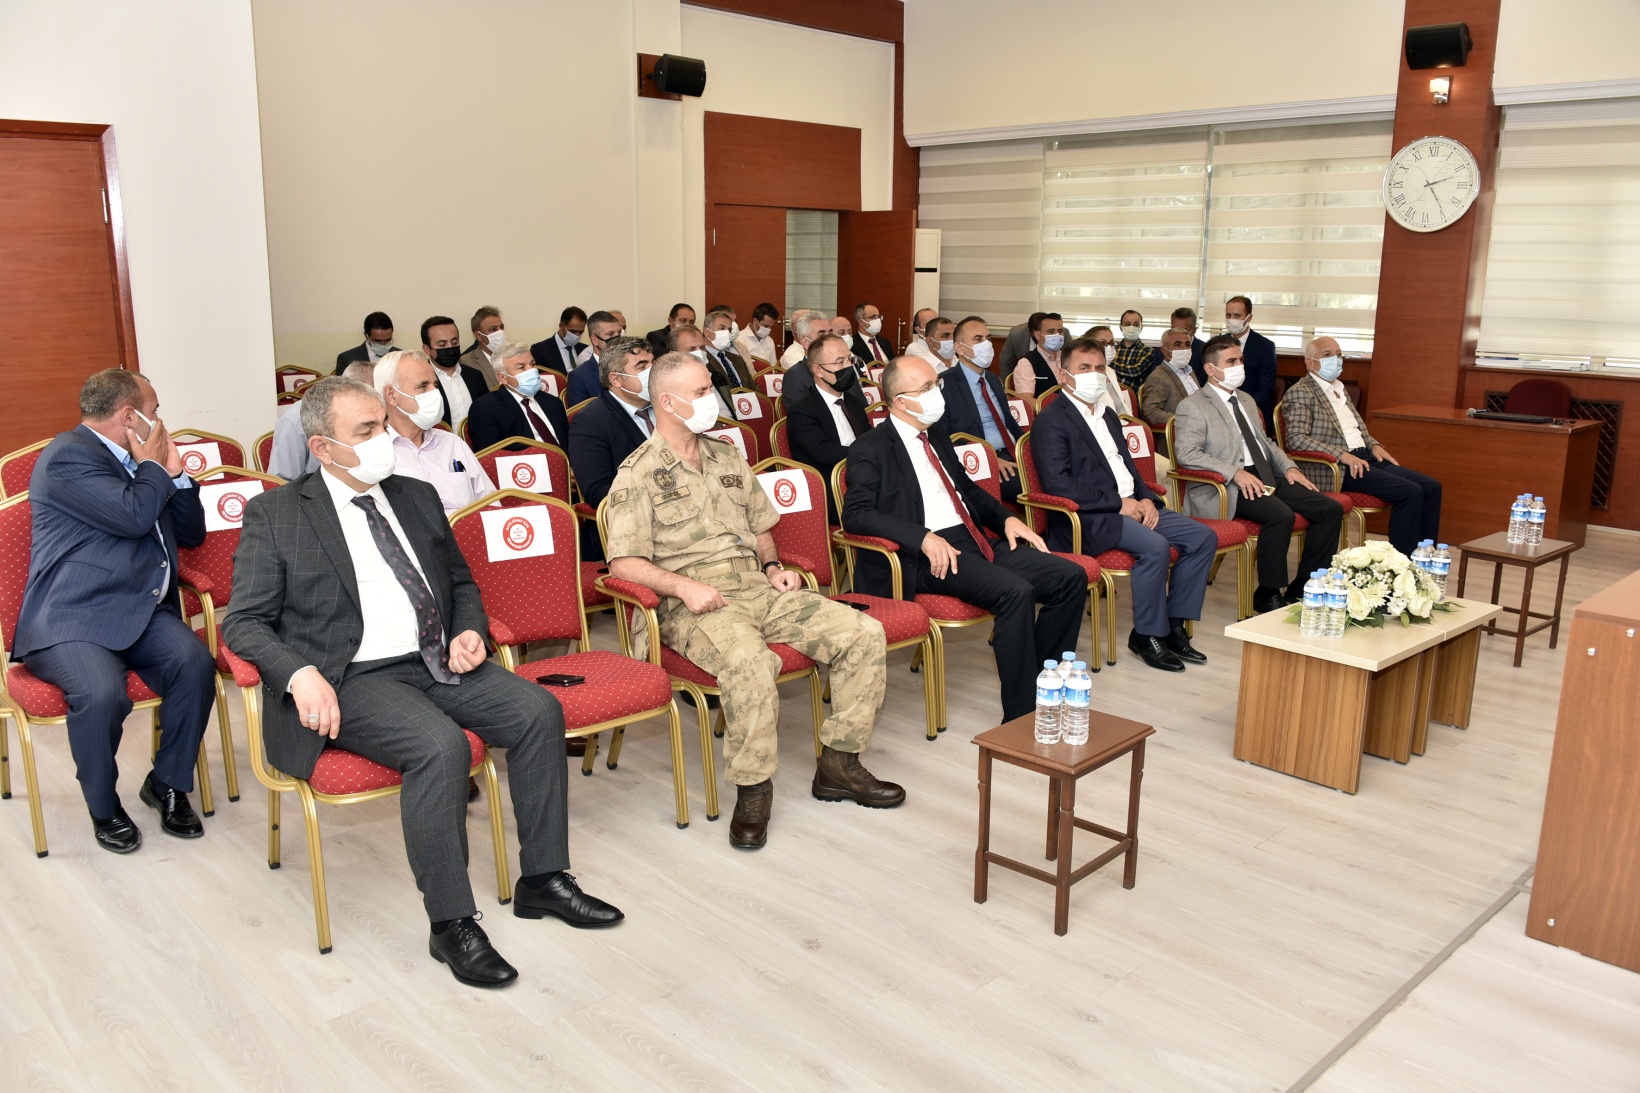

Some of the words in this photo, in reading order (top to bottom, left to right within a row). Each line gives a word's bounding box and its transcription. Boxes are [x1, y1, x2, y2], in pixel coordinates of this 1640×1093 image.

[1412, 150, 1422, 162] XI
[1428, 146, 1439, 157] XII
[1446, 151, 1453, 161] I
[1399, 164, 1409, 173] X
[1454, 164, 1466, 173] II
[1456, 181, 1468, 189] III
[1393, 193, 1406, 208] VIII
[1404, 206, 1416, 220] VII
[1421, 212, 1430, 223] VI
